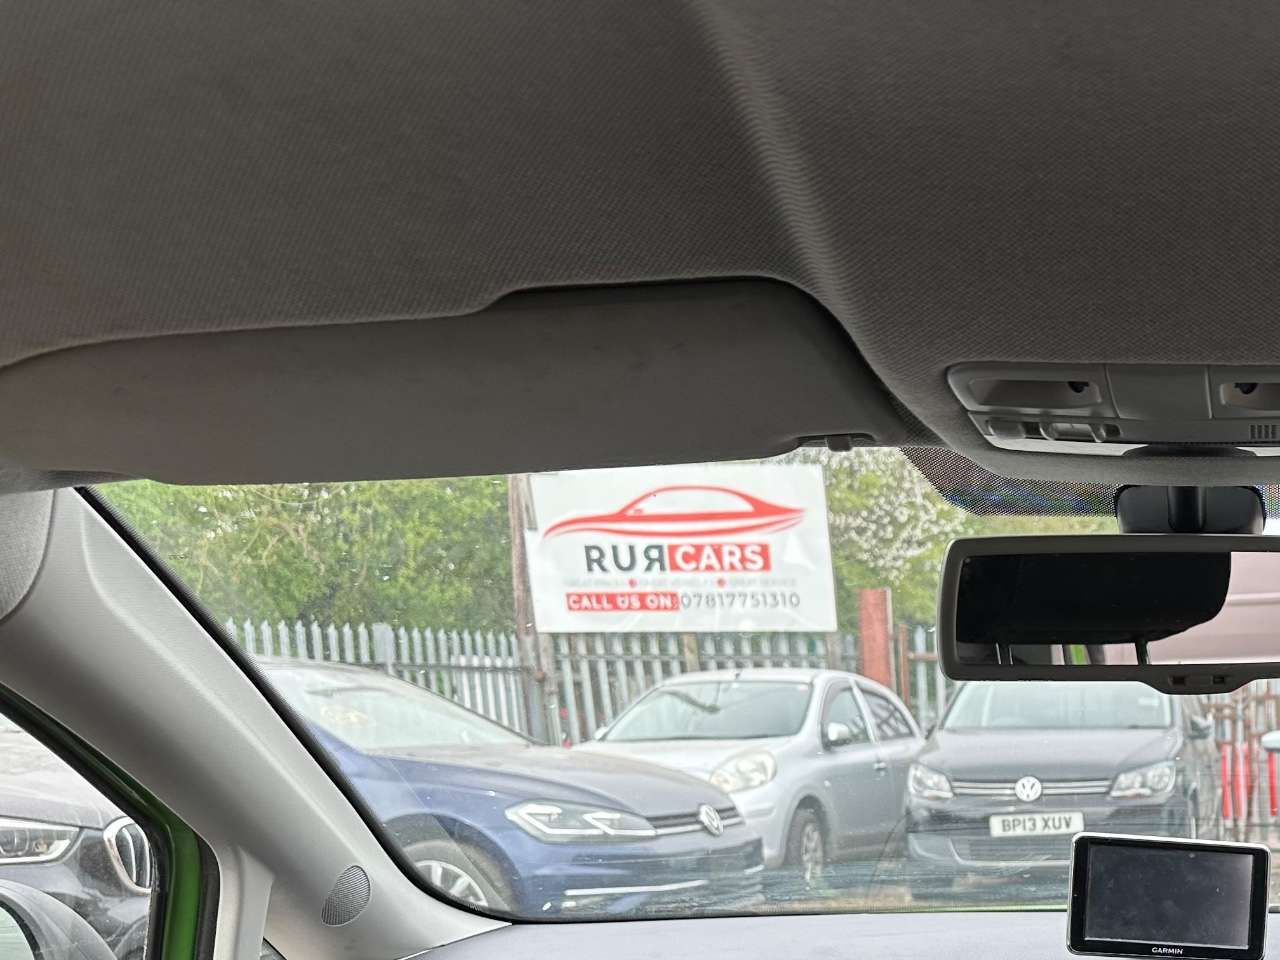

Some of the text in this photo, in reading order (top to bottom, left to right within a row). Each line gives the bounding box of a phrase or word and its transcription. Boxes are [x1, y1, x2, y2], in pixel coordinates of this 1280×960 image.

[674, 543, 765, 572] CARS
[568, 594, 613, 609] CALL
[616, 594, 641, 609] US
[680, 591, 801, 609] 07817751310
[1002, 815, 1072, 833] BP13 XUV
[1151, 946, 1184, 956] GARMIN
